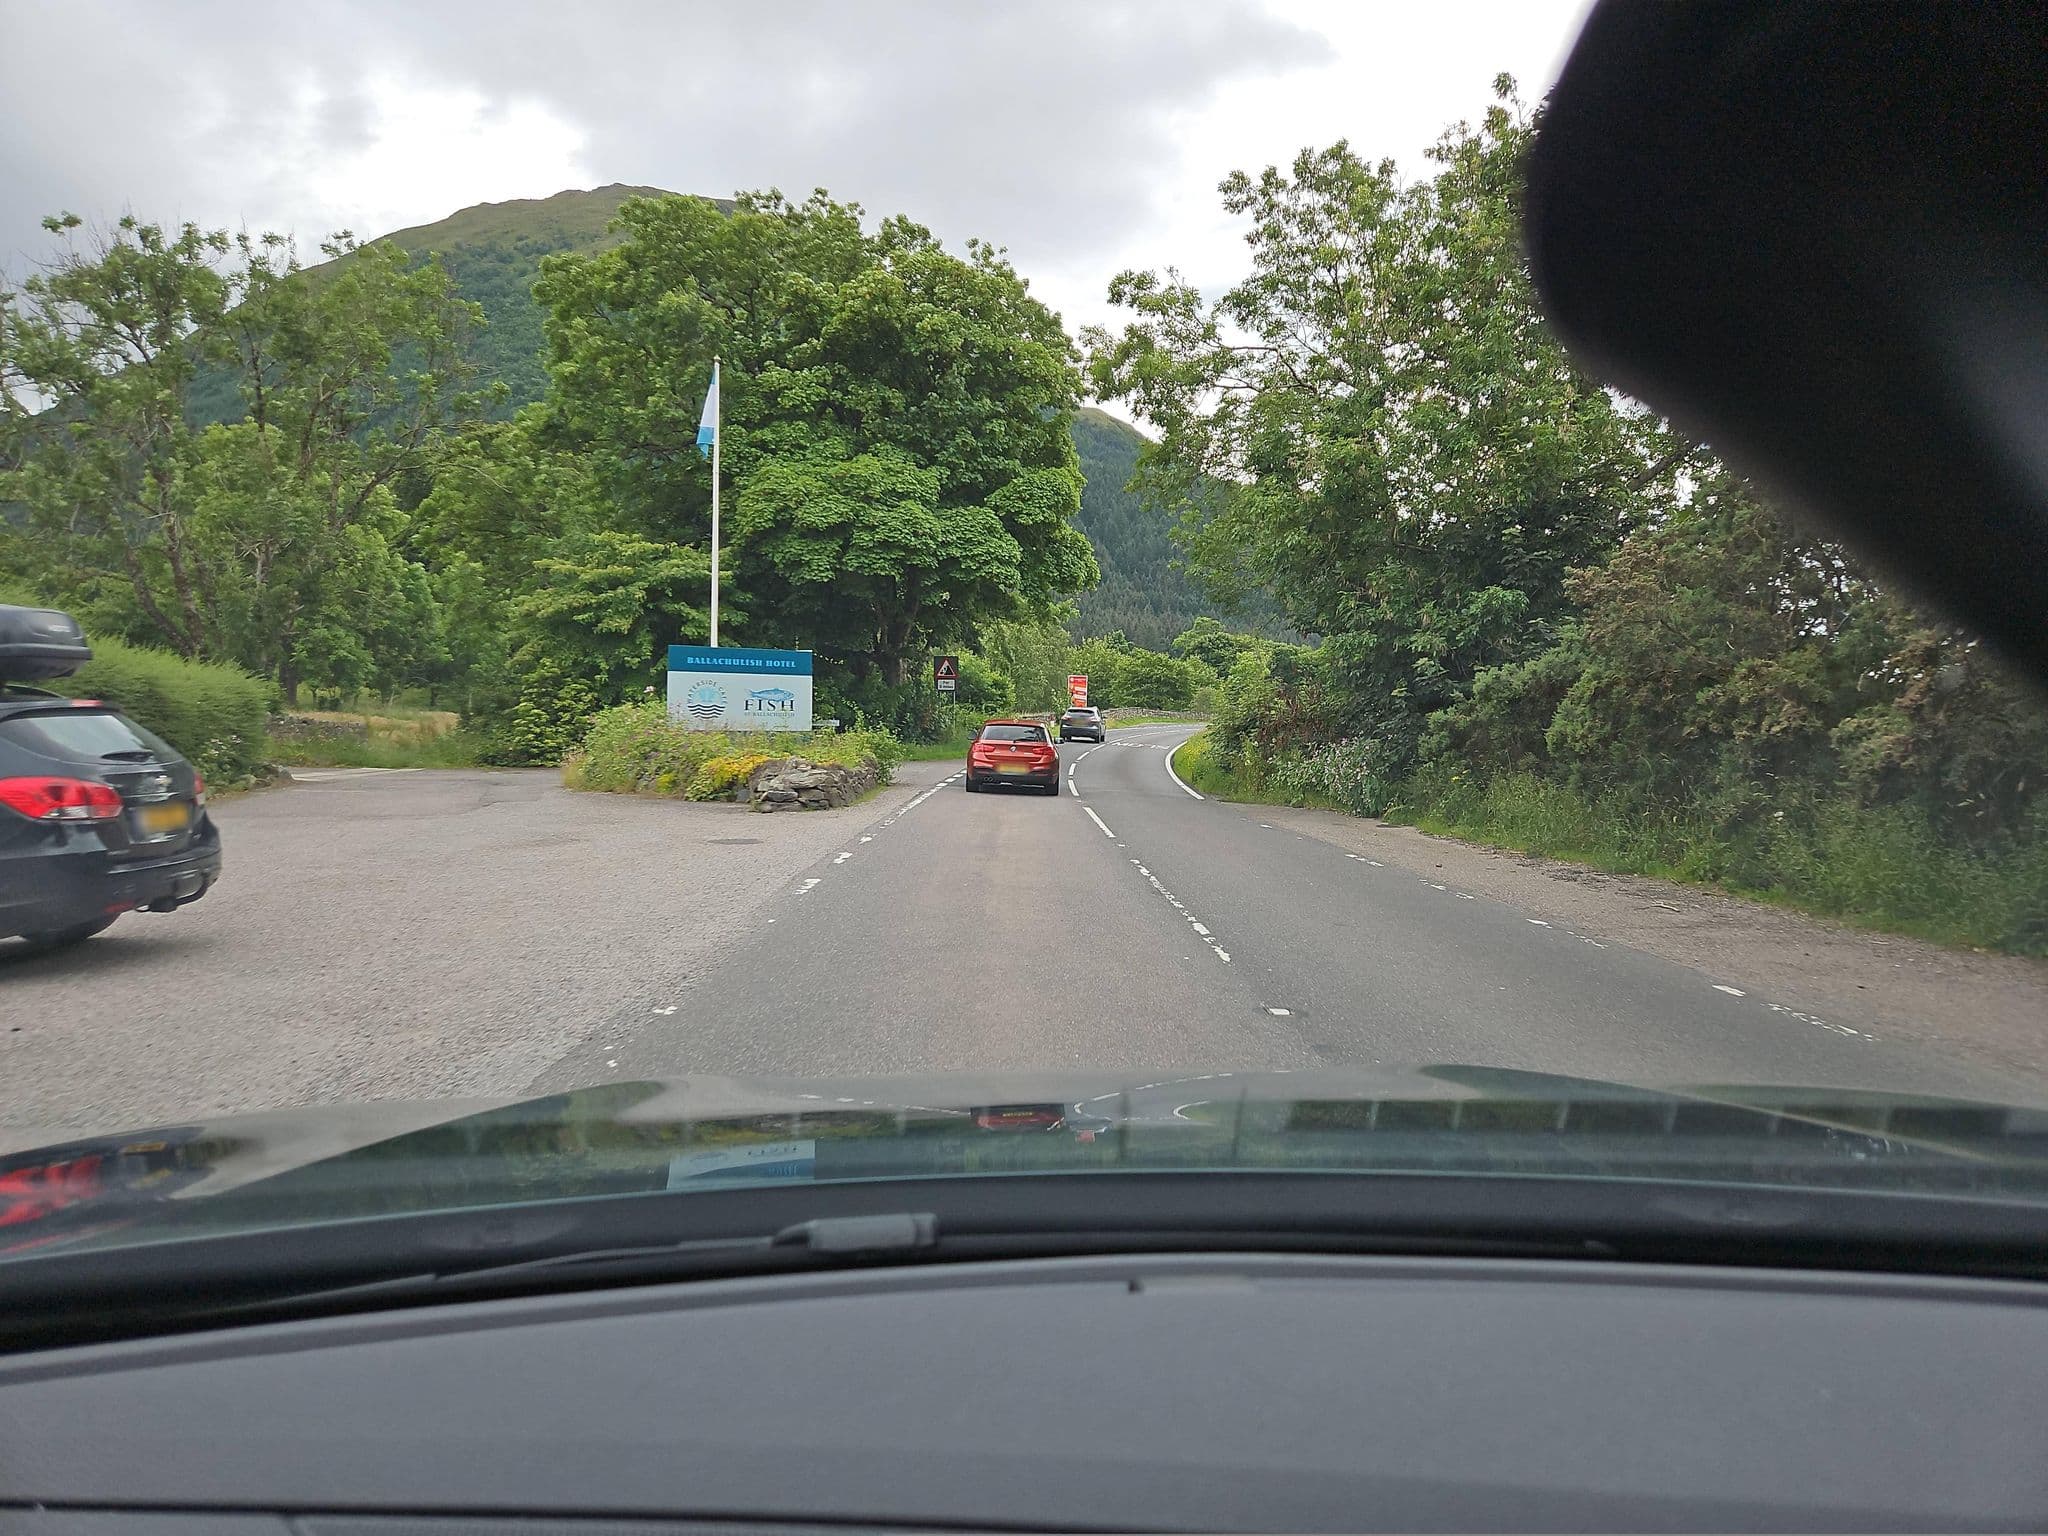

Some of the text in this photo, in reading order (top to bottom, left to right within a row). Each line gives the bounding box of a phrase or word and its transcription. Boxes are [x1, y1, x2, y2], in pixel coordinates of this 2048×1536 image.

[687, 656, 797, 668] BALLACHULISH HOTEL
[744, 699, 795, 711] FISH
